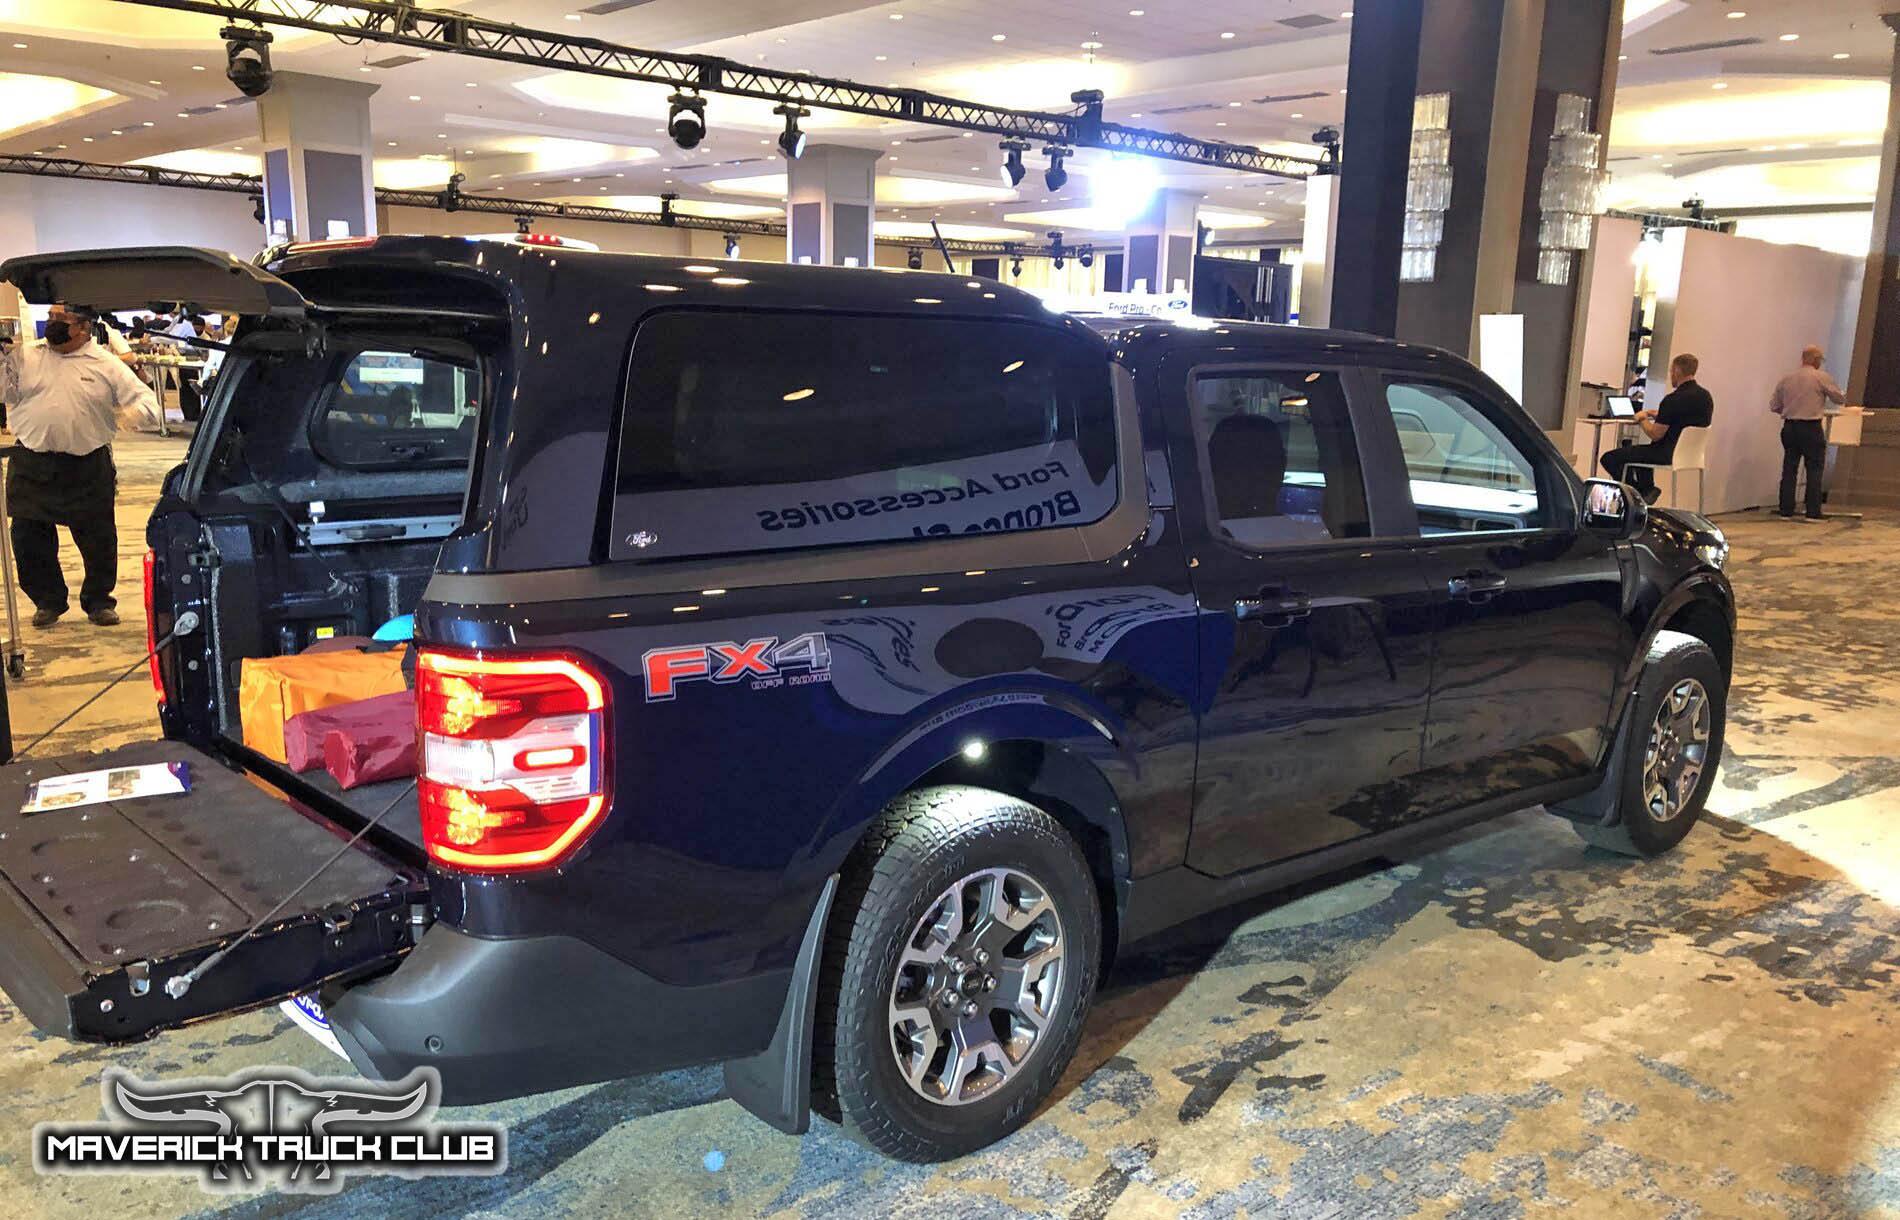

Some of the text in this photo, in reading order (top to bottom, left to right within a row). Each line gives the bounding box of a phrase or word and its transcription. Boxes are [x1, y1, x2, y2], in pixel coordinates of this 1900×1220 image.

[642, 632, 831, 704] FX4
[752, 673, 831, 690] OFF ROAD
